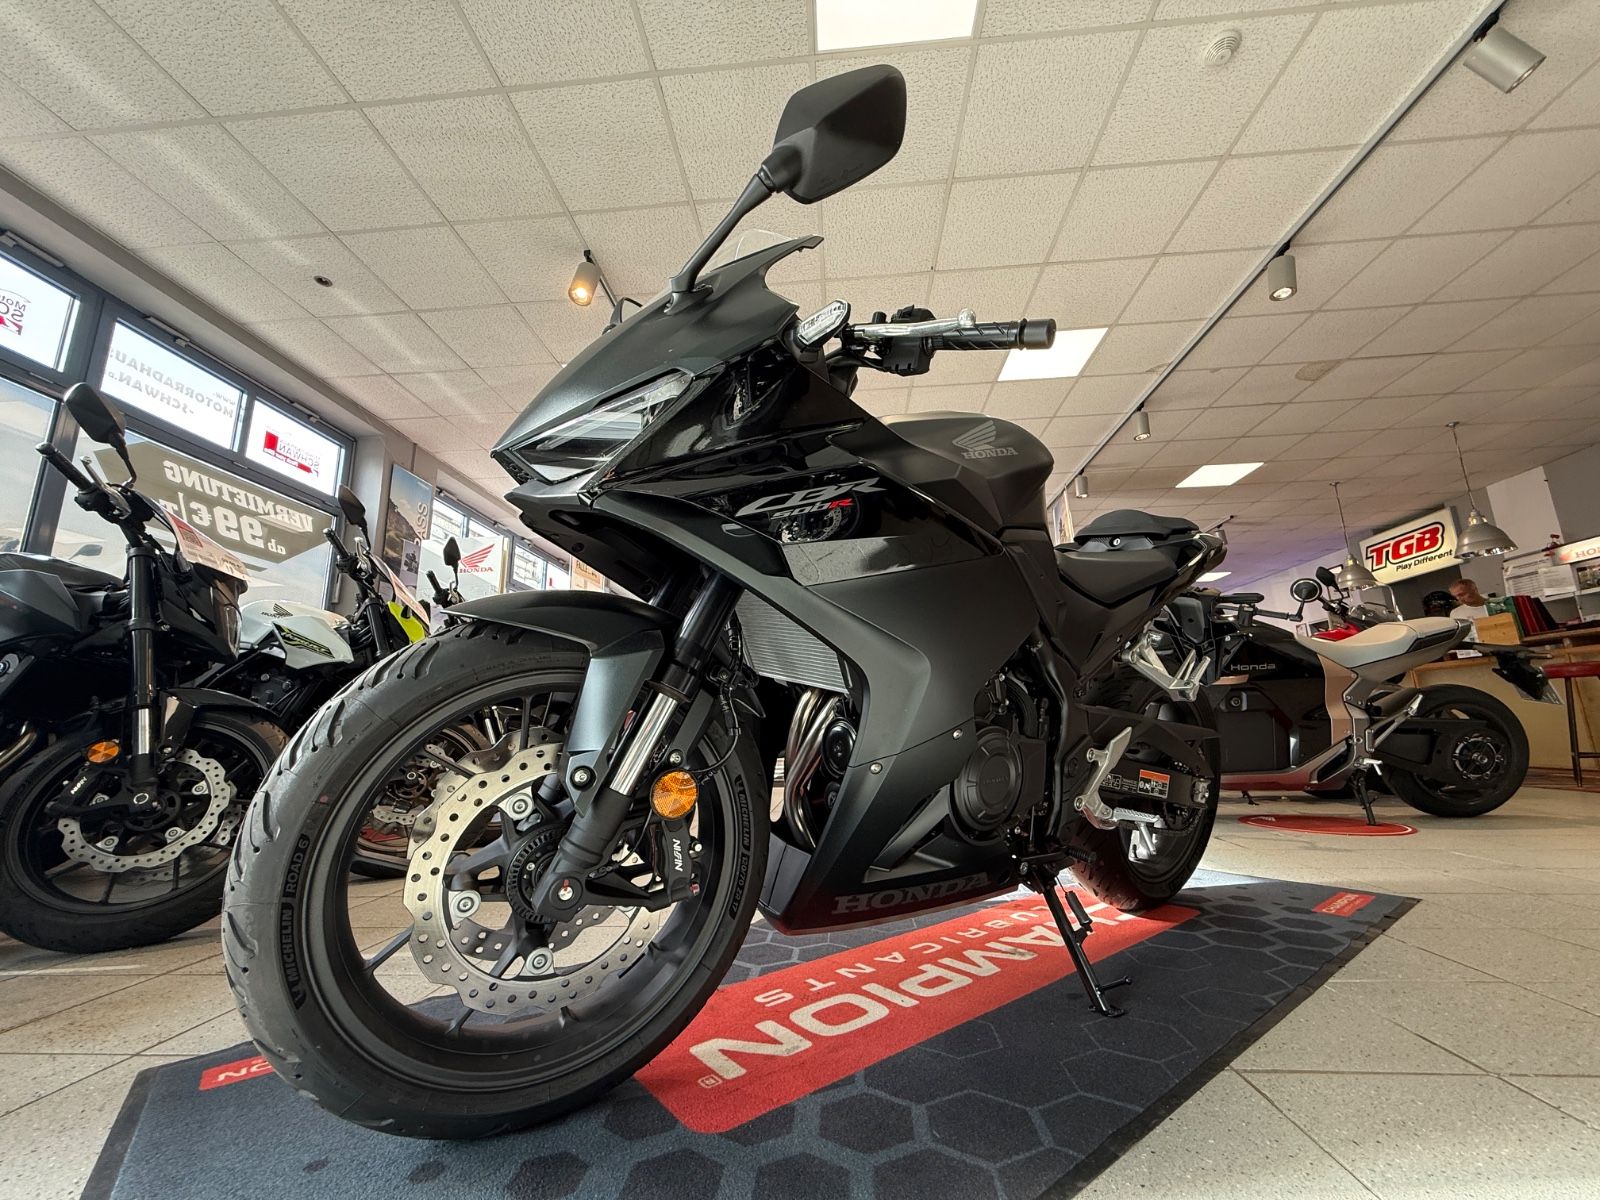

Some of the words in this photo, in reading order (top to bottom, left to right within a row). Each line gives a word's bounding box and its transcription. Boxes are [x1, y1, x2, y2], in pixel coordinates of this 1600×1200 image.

[960, 447, 1019, 460] HONDA
[735, 477, 888, 517] CBR
[1369, 526, 1441, 567] TGB
[1396, 561, 1412, 572] Play
[1414, 549, 1453, 567] Different
[1575, 547, 1600, 559] HO
[459, 566, 494, 574] HONDA
[1230, 662, 1276, 671] Honda
[740, 793, 750, 846] MICHELIN
[298, 838, 310, 849] 6
[672, 838, 684, 872] NISSIN
[285, 851, 304, 893] ROAD
[831, 871, 993, 915] HONDA
[281, 908, 299, 984] MICHELIN
